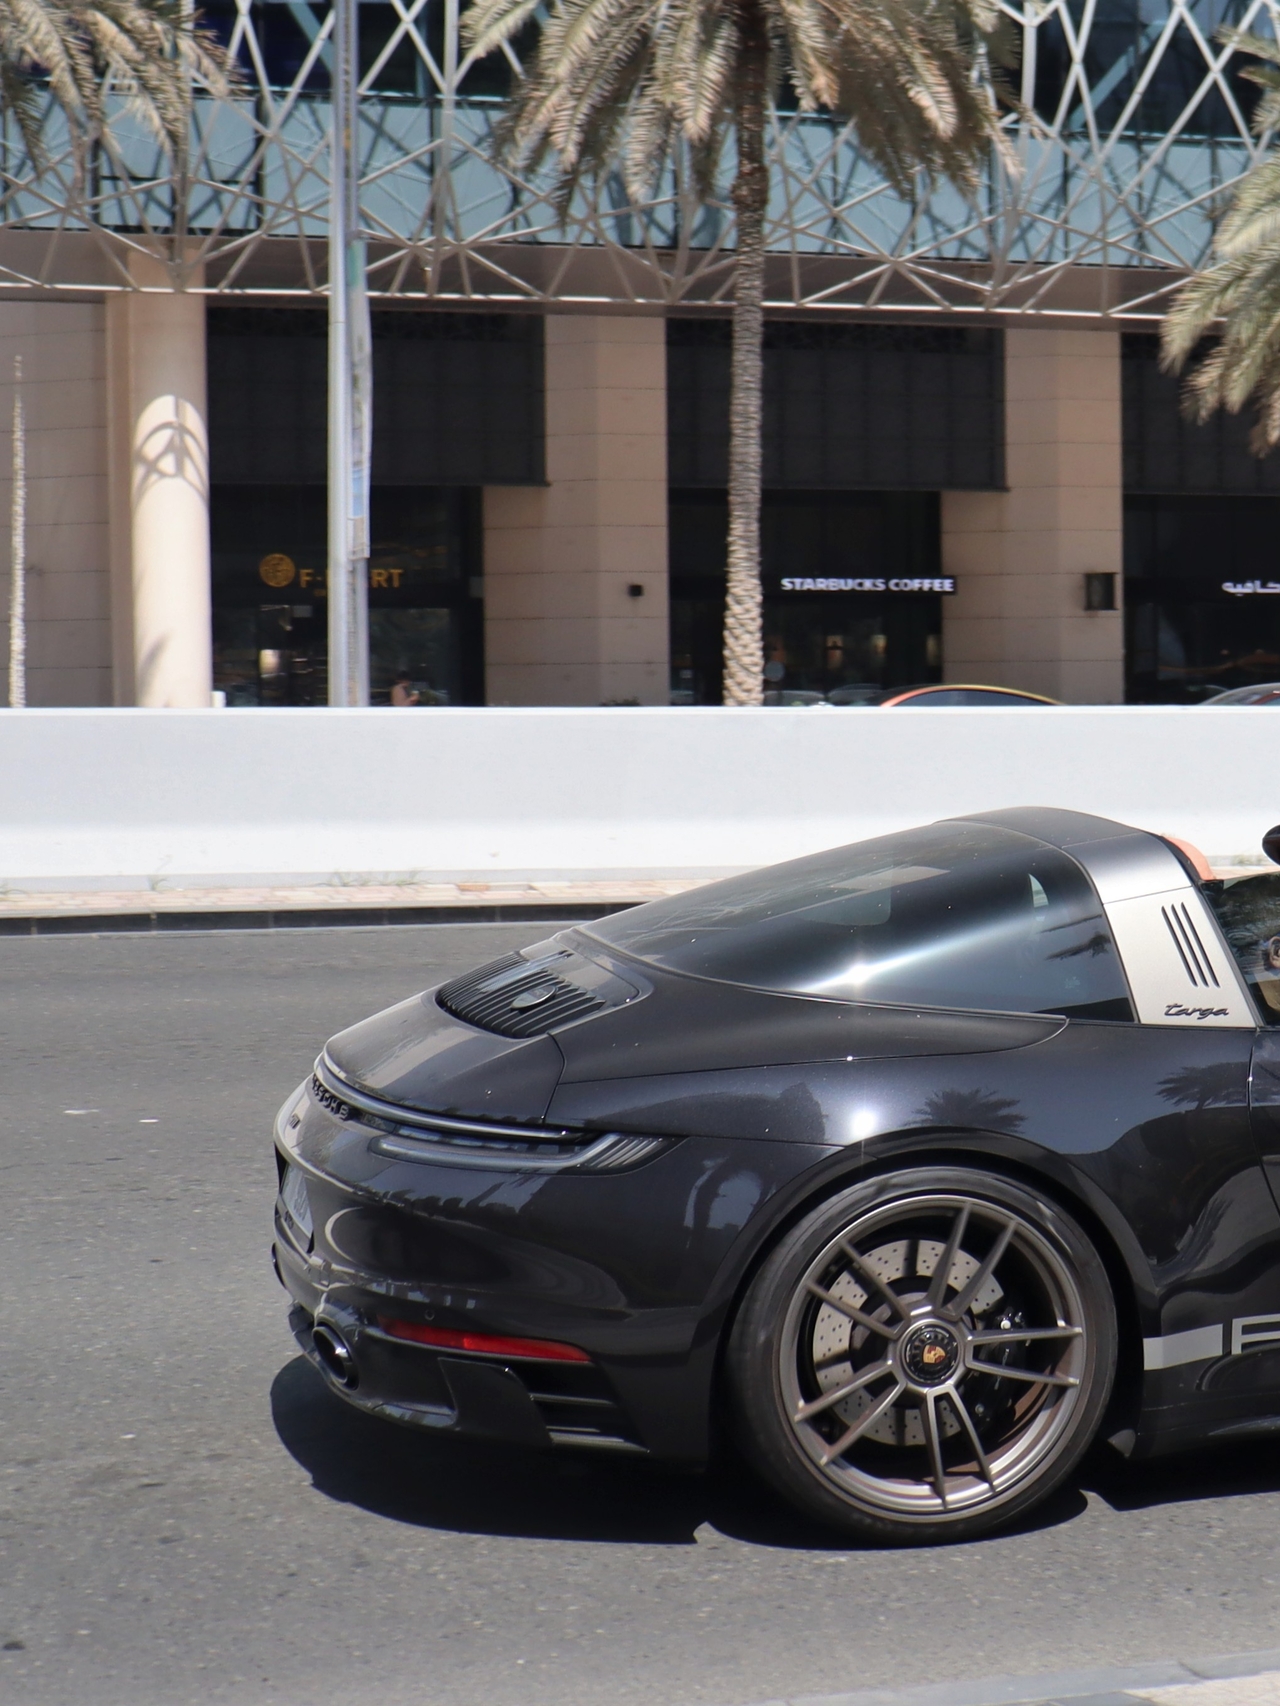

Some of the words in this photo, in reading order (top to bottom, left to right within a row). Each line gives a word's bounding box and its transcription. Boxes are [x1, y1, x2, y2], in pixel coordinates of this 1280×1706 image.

[780, 577, 887, 591] STARBUCKS
[888, 578, 954, 592] COFFEE
[1164, 1003, 1230, 1020] targa
